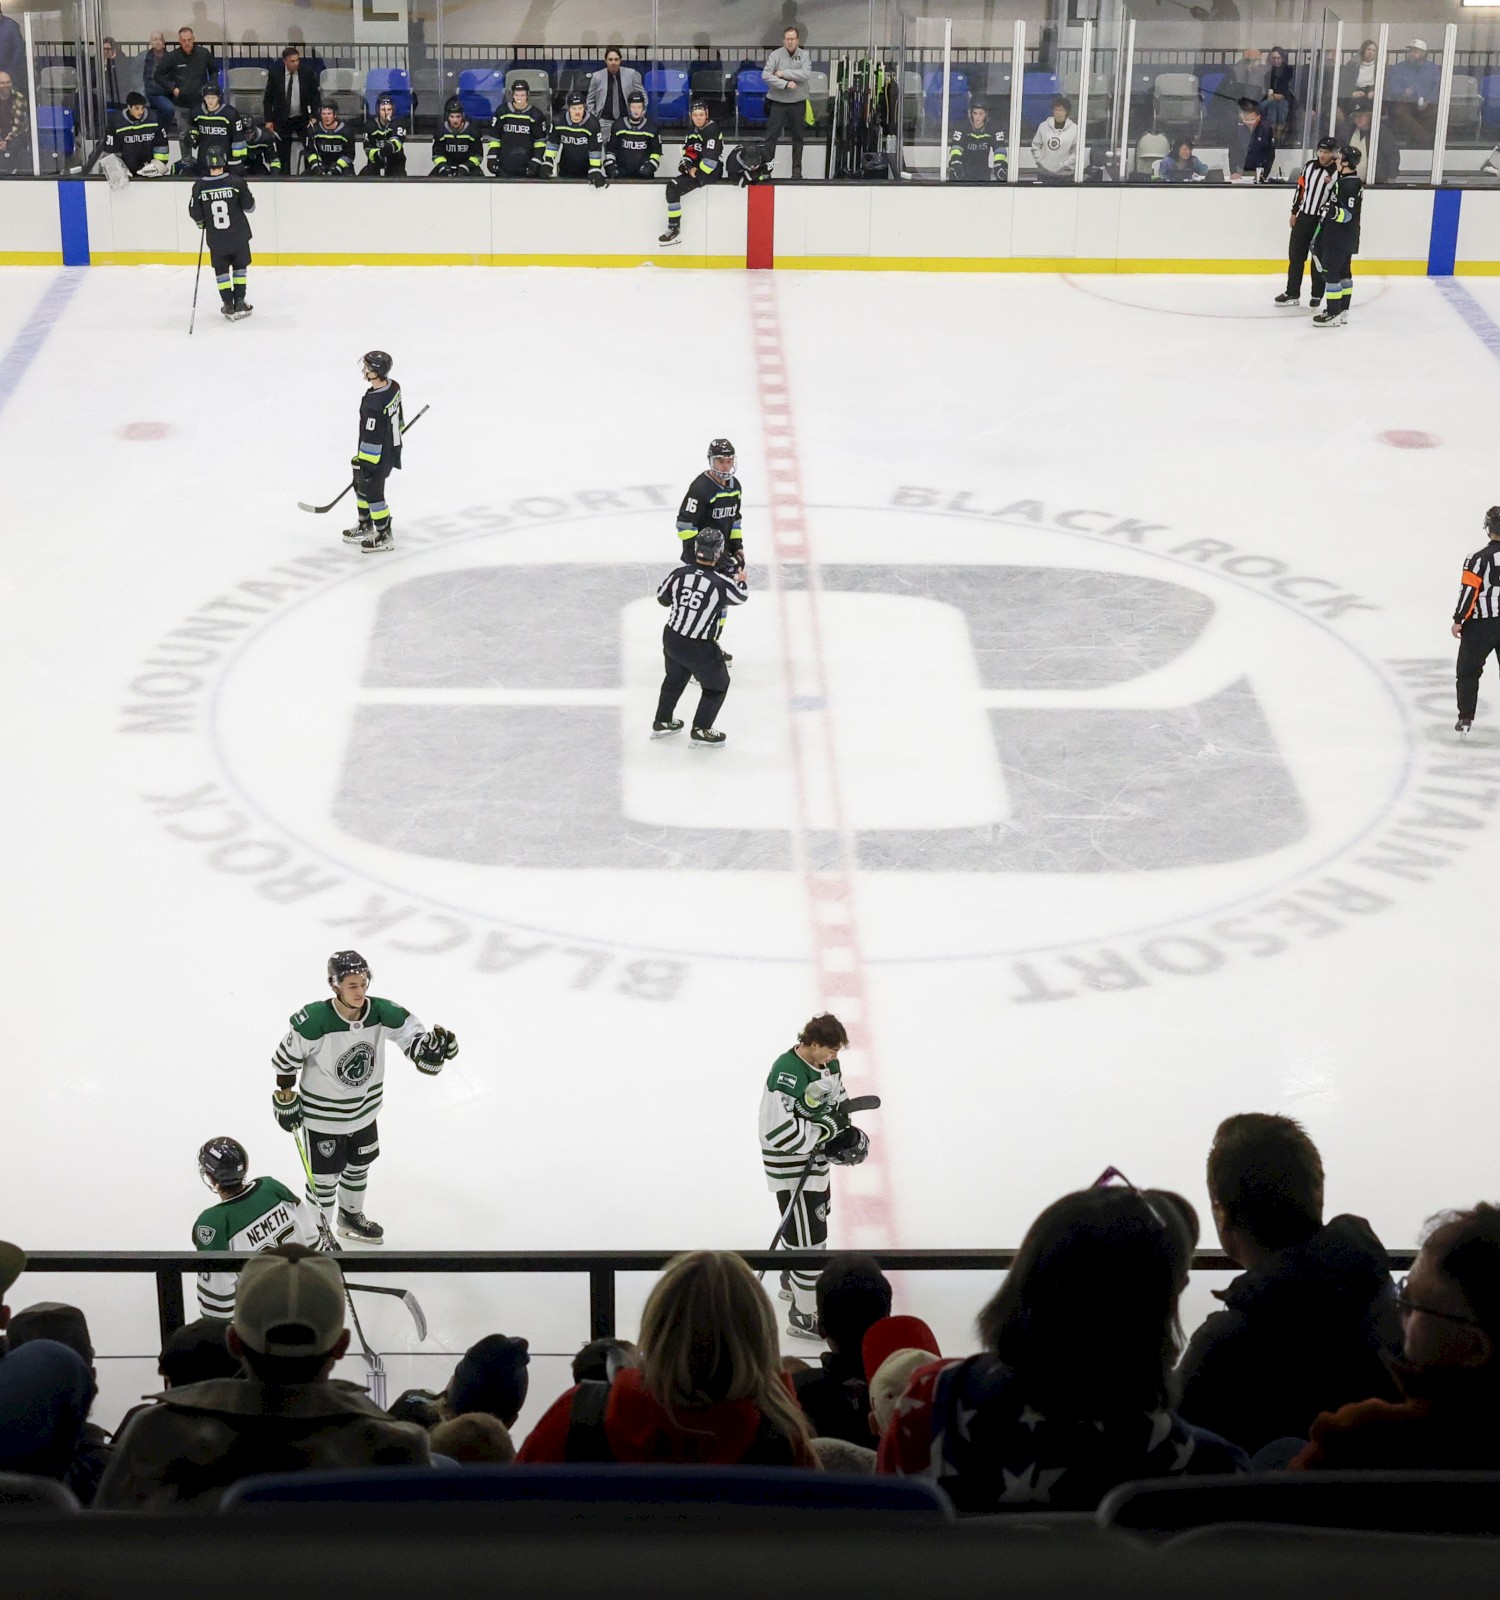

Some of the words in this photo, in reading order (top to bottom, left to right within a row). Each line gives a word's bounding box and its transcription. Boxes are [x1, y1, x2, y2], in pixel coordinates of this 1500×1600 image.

[707, 139, 715, 149] 19
[211, 200, 231, 229] 8
[1348, 197, 1355, 208] 6
[685, 497, 698, 513] 16
[887, 484, 1172, 544] BLACK
[1167, 536, 1385, 621] ROCK
[679, 588, 704, 609] 26
[140, 781, 346, 905] ROCK
[320, 892, 693, 1003] BLACK
[1010, 876, 1396, 1005] RESORT
[246, 1205, 290, 1247] NEMETH
